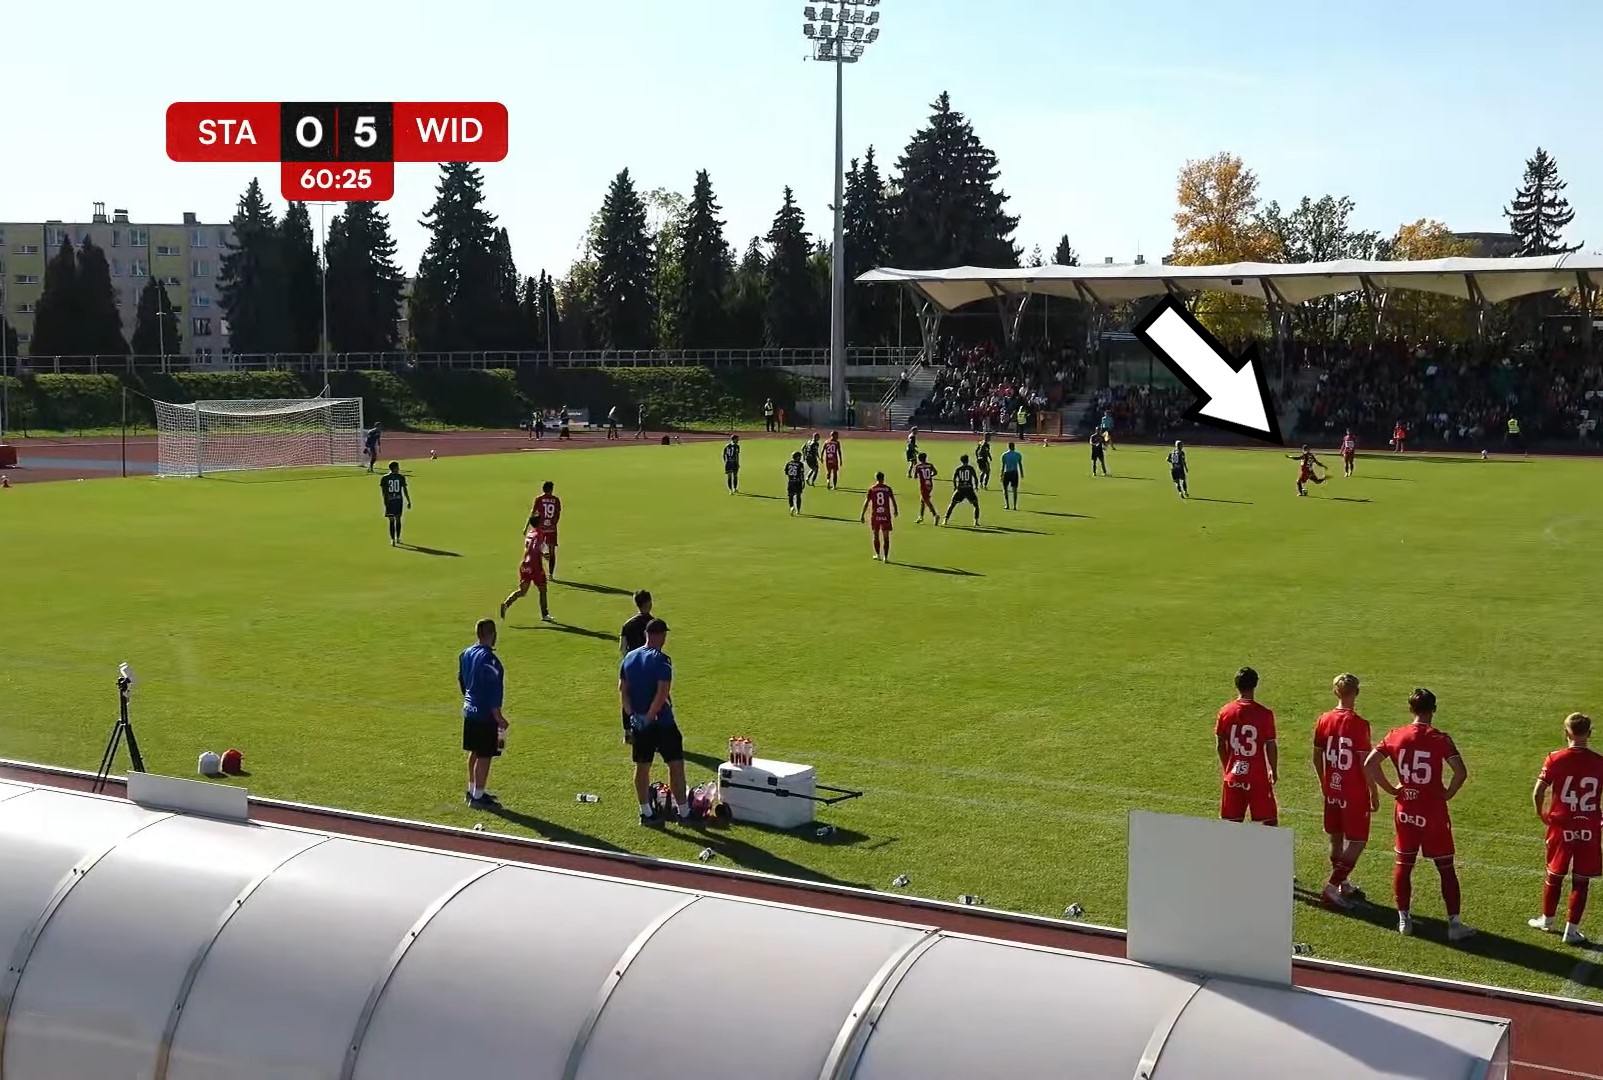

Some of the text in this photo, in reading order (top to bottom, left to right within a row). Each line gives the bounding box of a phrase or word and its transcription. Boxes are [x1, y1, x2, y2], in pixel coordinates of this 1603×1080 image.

[388, 479, 400, 493] 30
[920, 468, 931, 480] 10
[876, 491, 885, 506] 8
[542, 503, 555, 519] 19
[1230, 724, 1258, 757] 43
[1326, 735, 1353, 771] 46
[1398, 748, 1432, 785] 45
[1560, 775, 1599, 812] 42
